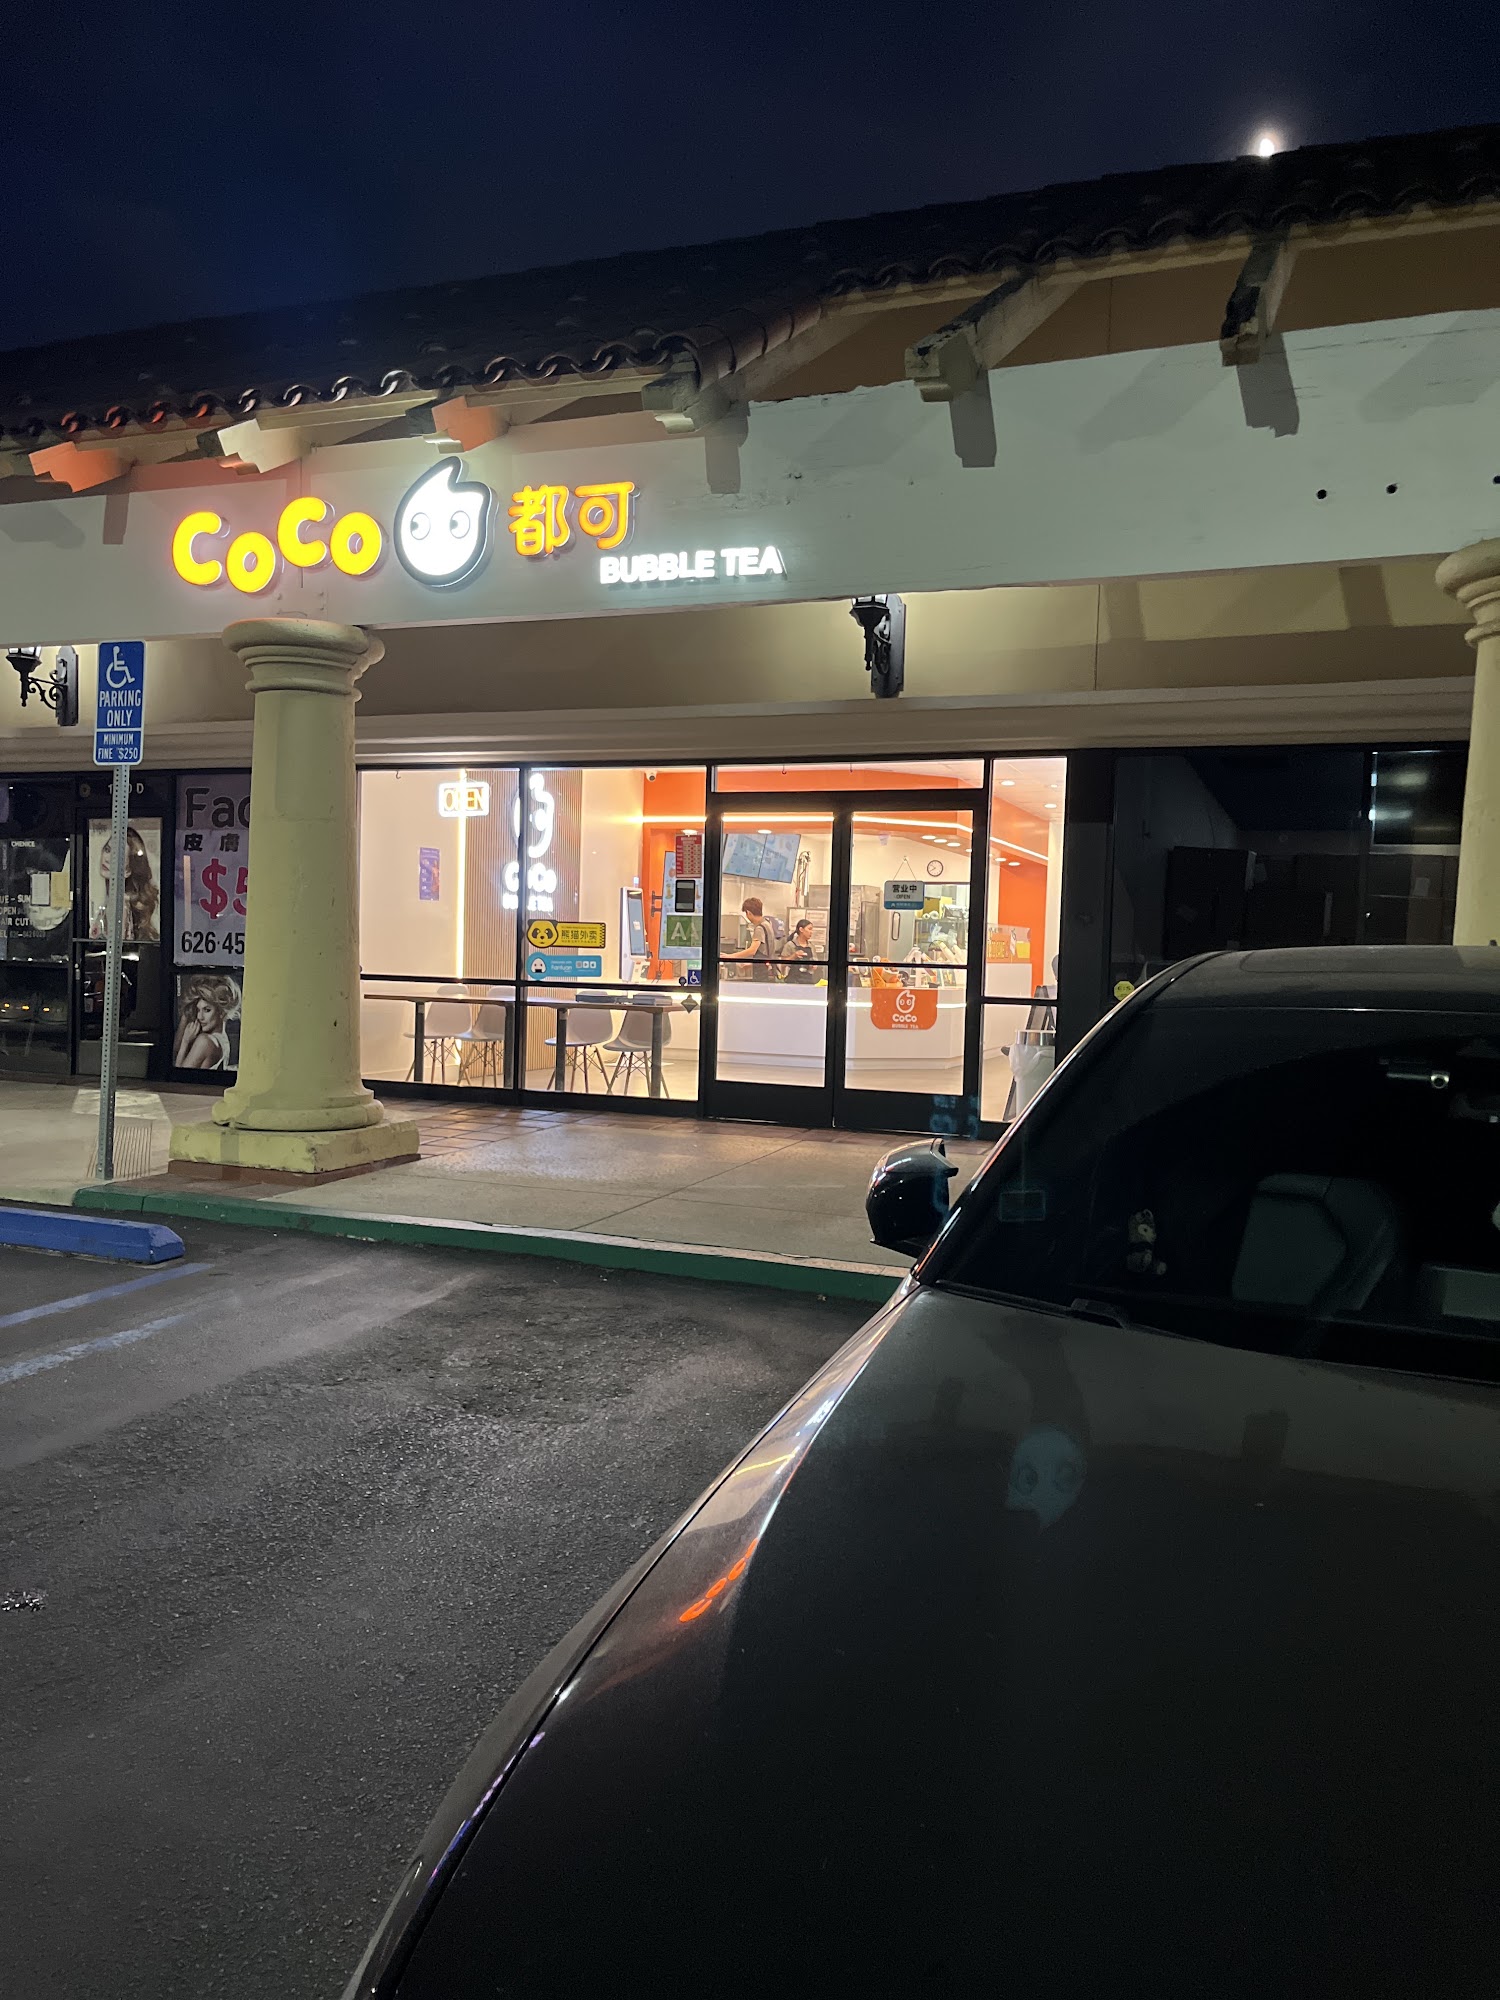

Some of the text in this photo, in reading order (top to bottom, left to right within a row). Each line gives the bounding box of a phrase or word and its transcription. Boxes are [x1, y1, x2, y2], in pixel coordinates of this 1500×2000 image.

[508, 481, 636, 556] 都可
[172, 496, 382, 593] CoCo
[600, 545, 785, 584] BUBBLE TEA
[99, 689, 142, 707] PARKING
[106, 709, 133, 727] ONLY
[103, 733, 134, 745] MINIMUM
[98, 747, 139, 760] FINE $250
